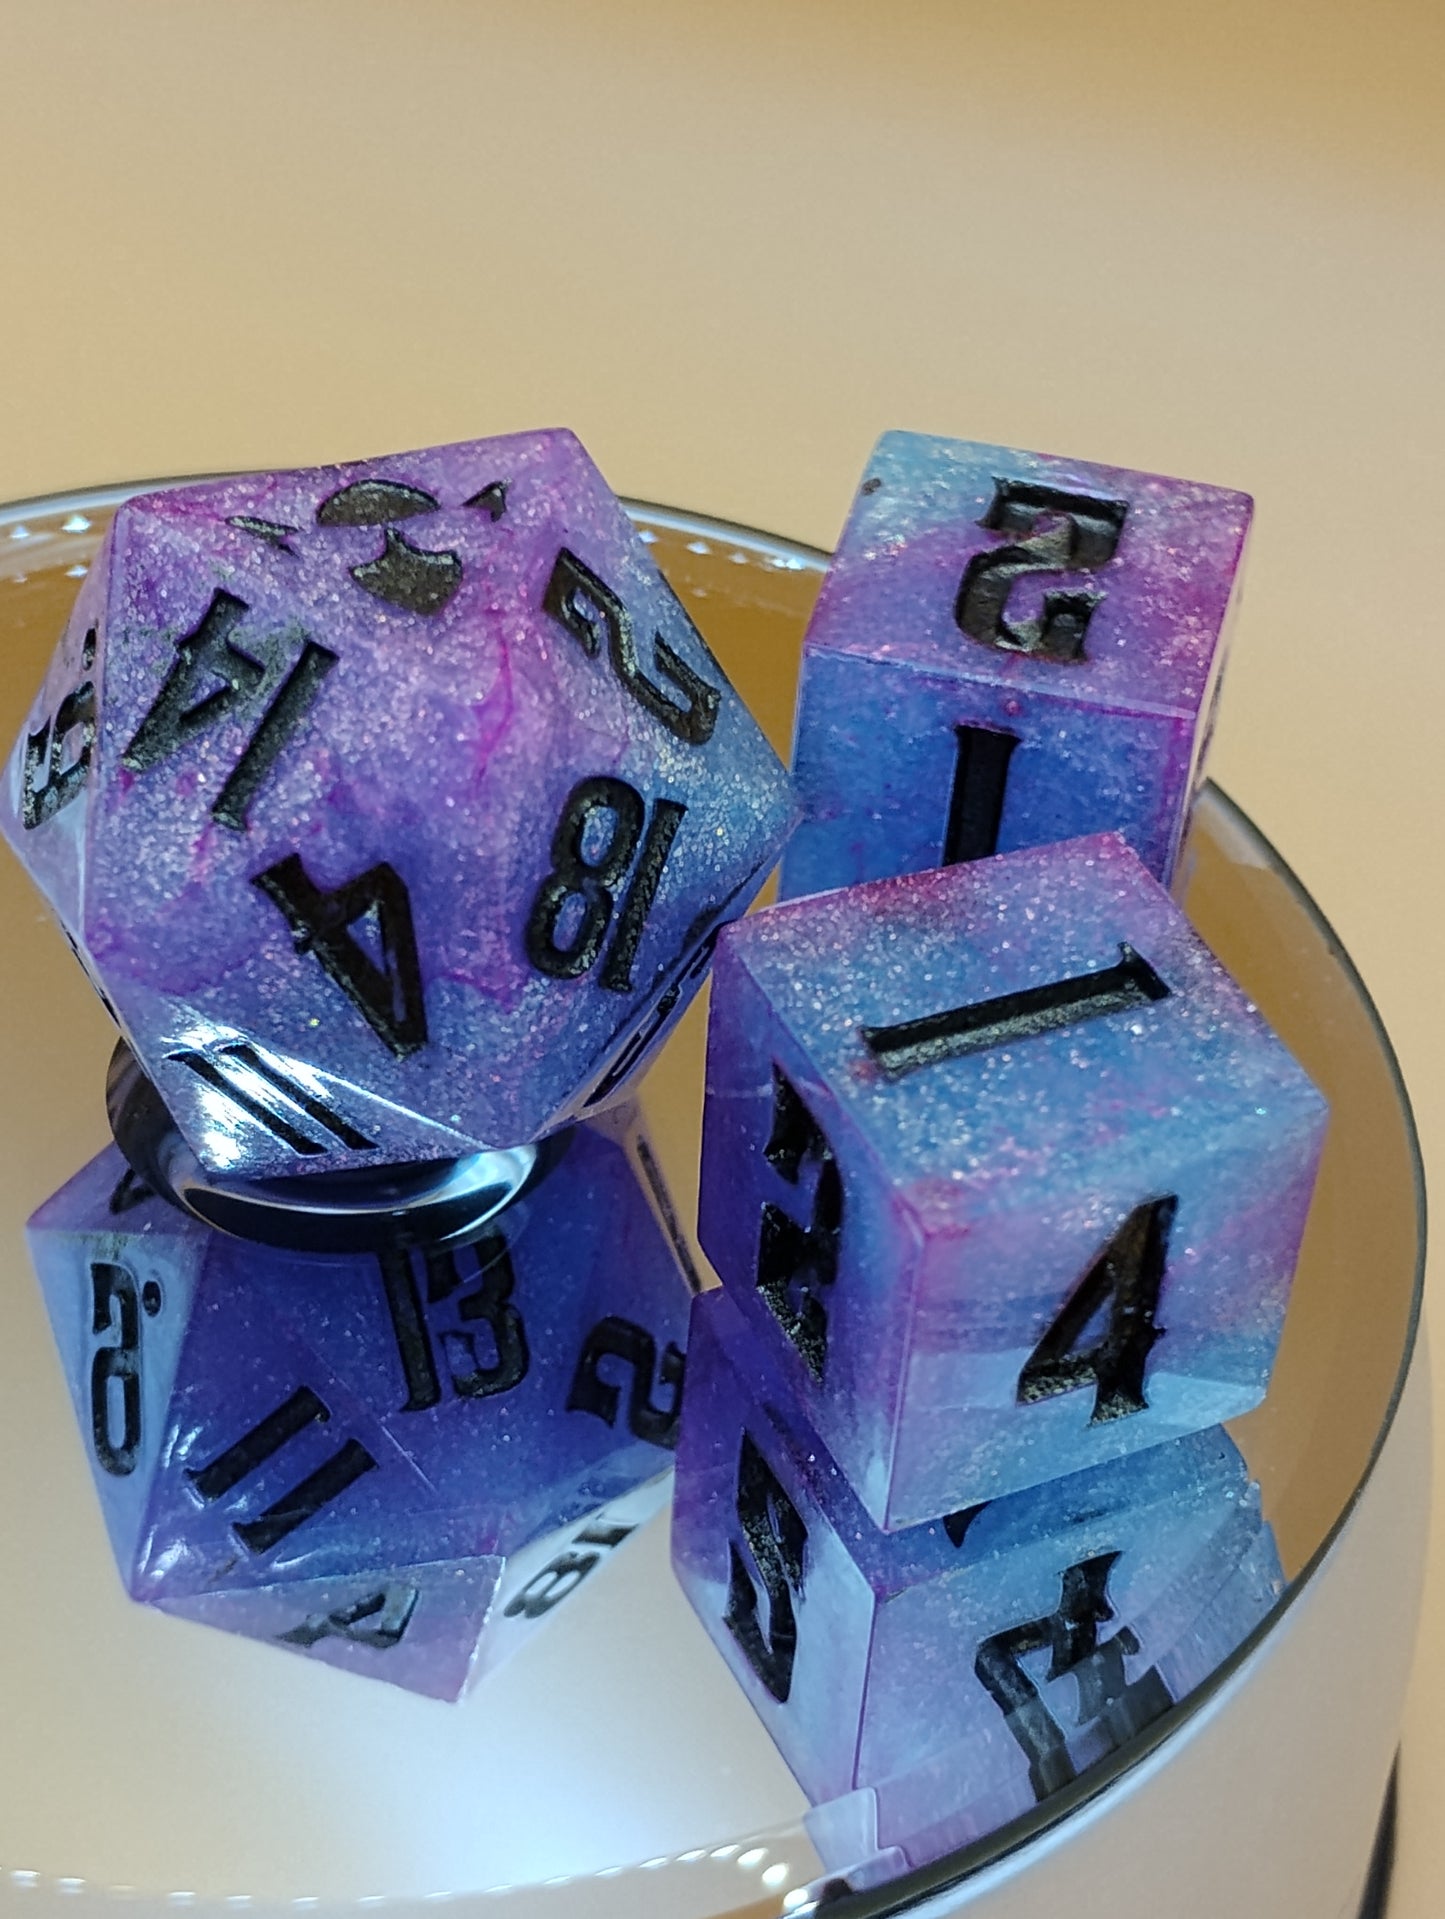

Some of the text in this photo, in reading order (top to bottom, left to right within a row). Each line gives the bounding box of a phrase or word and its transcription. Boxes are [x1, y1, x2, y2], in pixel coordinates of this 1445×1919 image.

[542, 547, 721, 745] 2
[953, 475, 1129, 663] 2
[122, 588, 340, 832] 14
[250, 853, 428, 1060] 4
[525, 776, 689, 992] 18
[163, 1042, 378, 1156] 11
[860, 942, 1172, 1082] 1
[1016, 1194, 1179, 1427] 4
